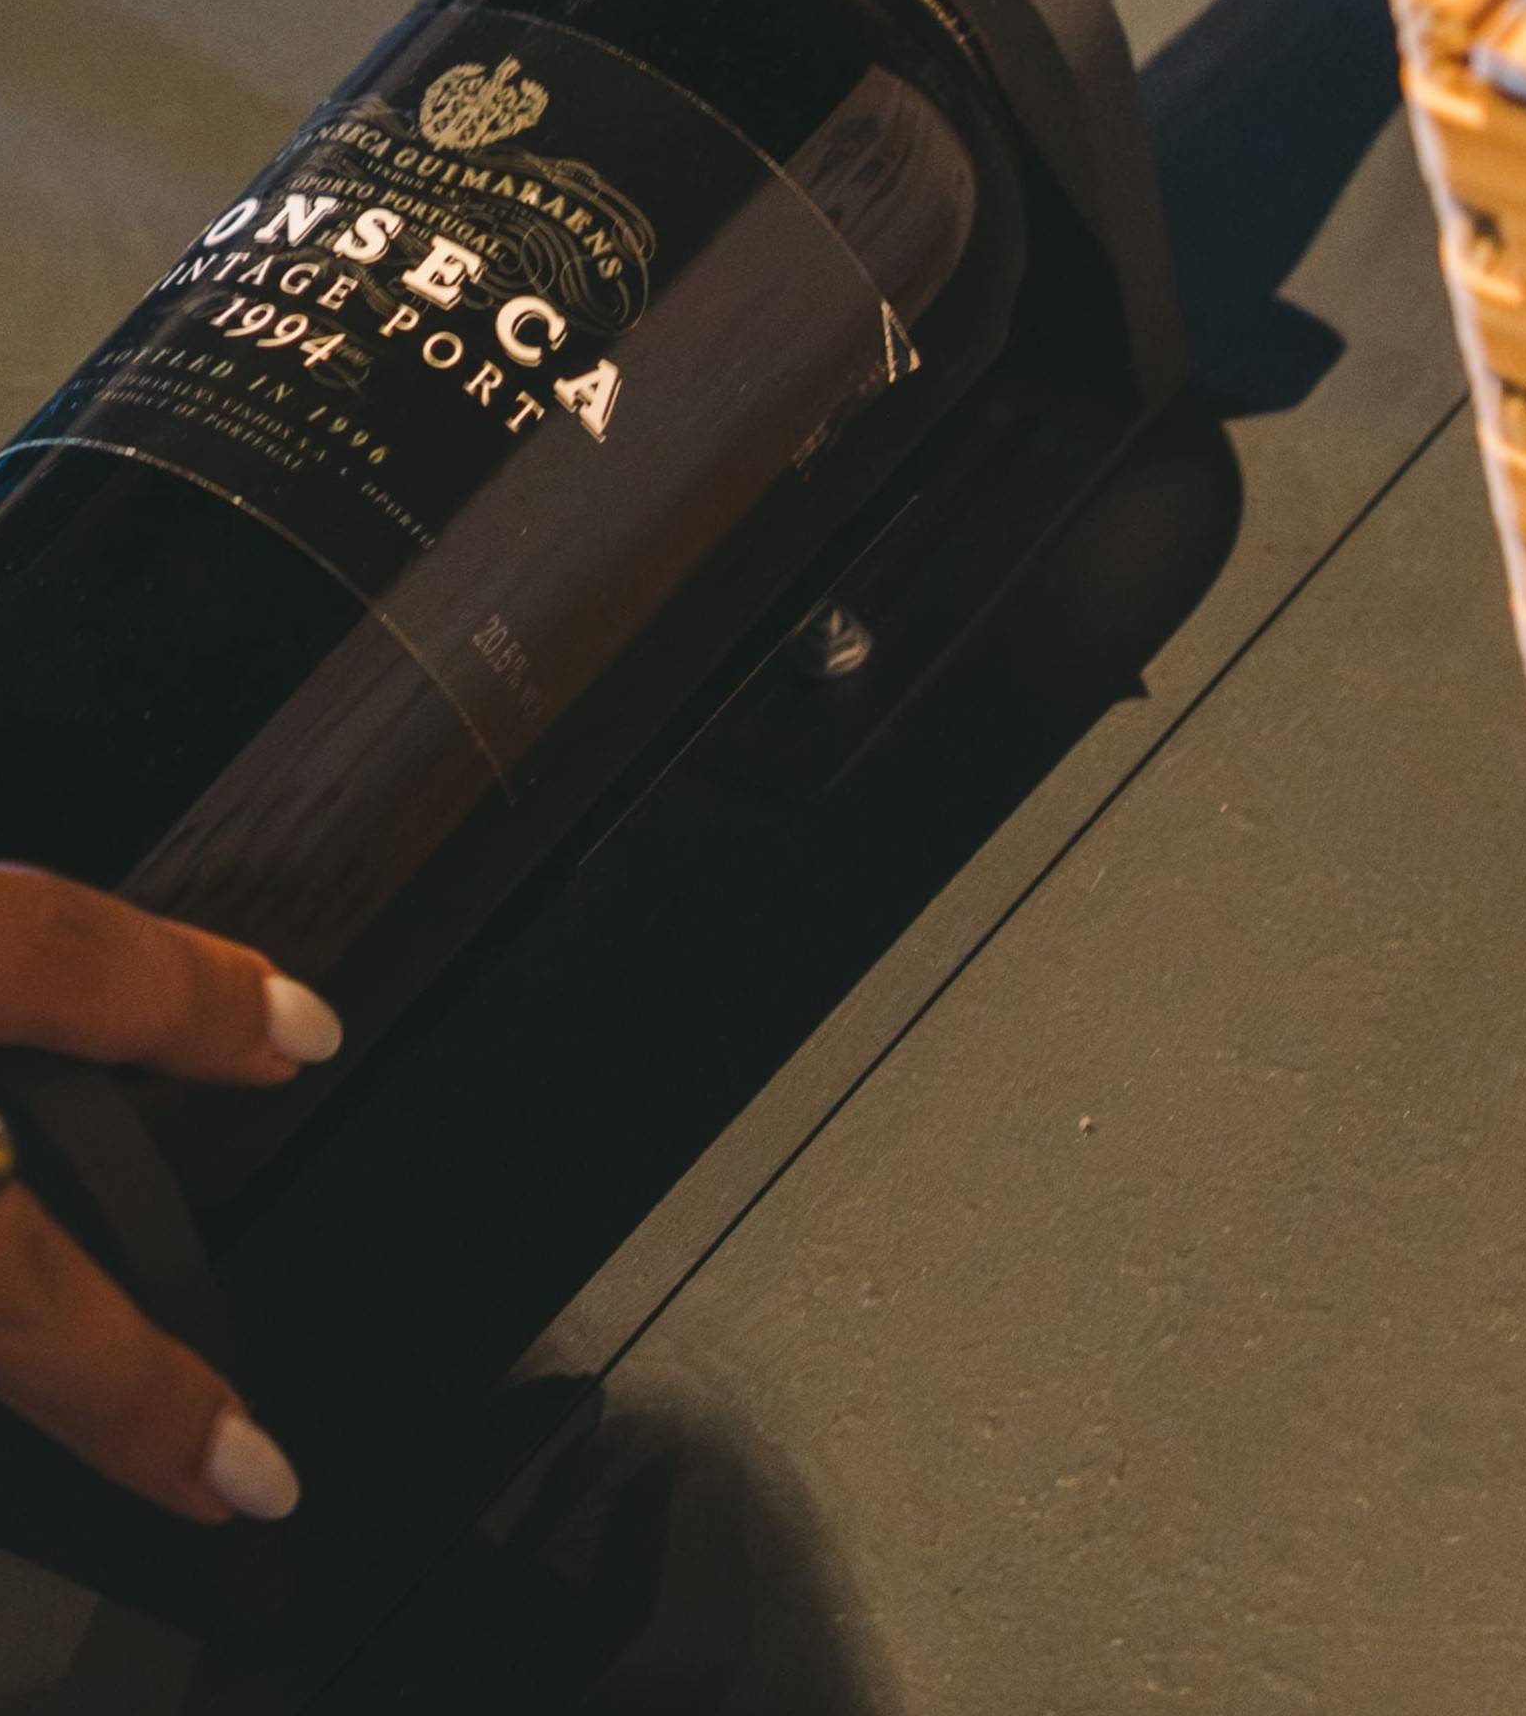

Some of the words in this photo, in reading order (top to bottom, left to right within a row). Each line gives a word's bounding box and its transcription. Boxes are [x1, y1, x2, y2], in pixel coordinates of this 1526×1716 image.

[158, 252, 359, 311] INTAGE
[379, 304, 545, 435] PORT
[203, 192, 622, 444] ONSECA
[210, 297, 348, 370] 1994
[248, 373, 295, 404] IN
[308, 405, 389, 466] 1996
